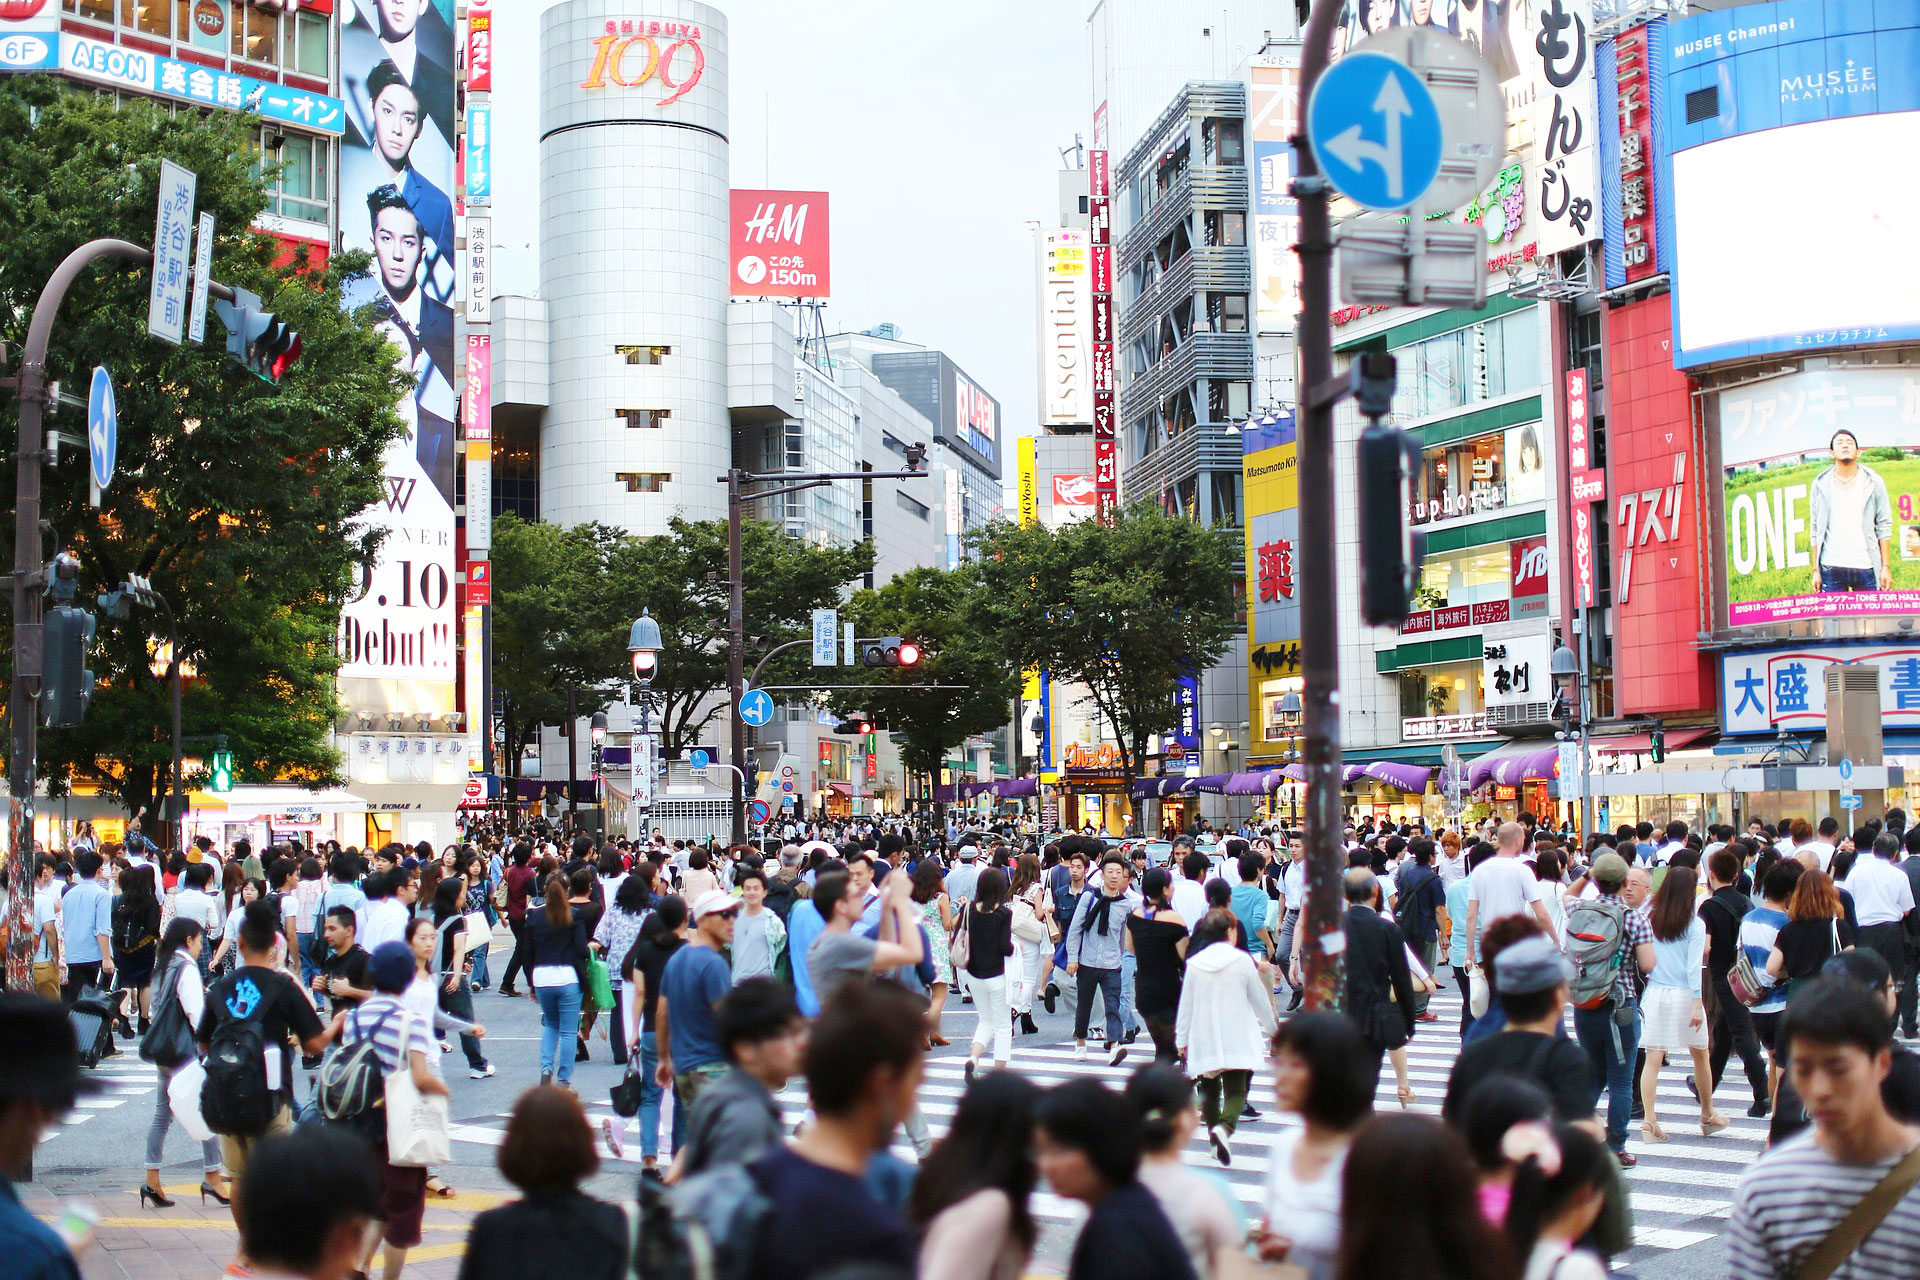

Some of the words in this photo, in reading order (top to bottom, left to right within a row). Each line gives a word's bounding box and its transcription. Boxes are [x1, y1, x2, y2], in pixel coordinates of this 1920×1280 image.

[5, 42, 36, 61] 6F
[605, 19, 702, 40] SHIBUYA
[1675, 34, 1723, 59] MUSEE
[1728, 17, 1795, 42] Channel
[71, 41, 148, 83] AEON
[472, 30, 488, 80] ガスト
[579, 34, 705, 107] 109
[161, 62, 338, 124] 英会話イーオン
[1781, 82, 1876, 104] PLATINUM
[1536, 7, 1593, 236] もんじゃ
[1616, 37, 1647, 268] 三千里薬品
[472, 196, 485, 205] 6F
[159, 199, 172, 264] Shibuya
[745, 202, 808, 245] H&M
[165, 182, 190, 327] 渋谷駅前
[472, 226, 485, 313] 渋谷駅前ビル
[769, 255, 805, 268] この先
[769, 268, 817, 286] 150m
[469, 336, 488, 347] 5F
[1049, 280, 1077, 418] Essential
[1793, 327, 1889, 346] ミュゼプラチナム
[968, 382, 995, 441] LABI
[1617, 452, 1686, 604] クスリ
[1731, 484, 1810, 577] ONE
[1257, 538, 1294, 603] 薬
[1515, 545, 1548, 586] JTB
[1437, 610, 1467, 626] 海外旅行
[1474, 611, 1509, 624] ウエディング
[1475, 601, 1506, 614] ハネムーン
[345, 615, 449, 668] Debut!!
[823, 615, 833, 660] 渋谷駅前
[1734, 657, 1920, 717] 大盛書
